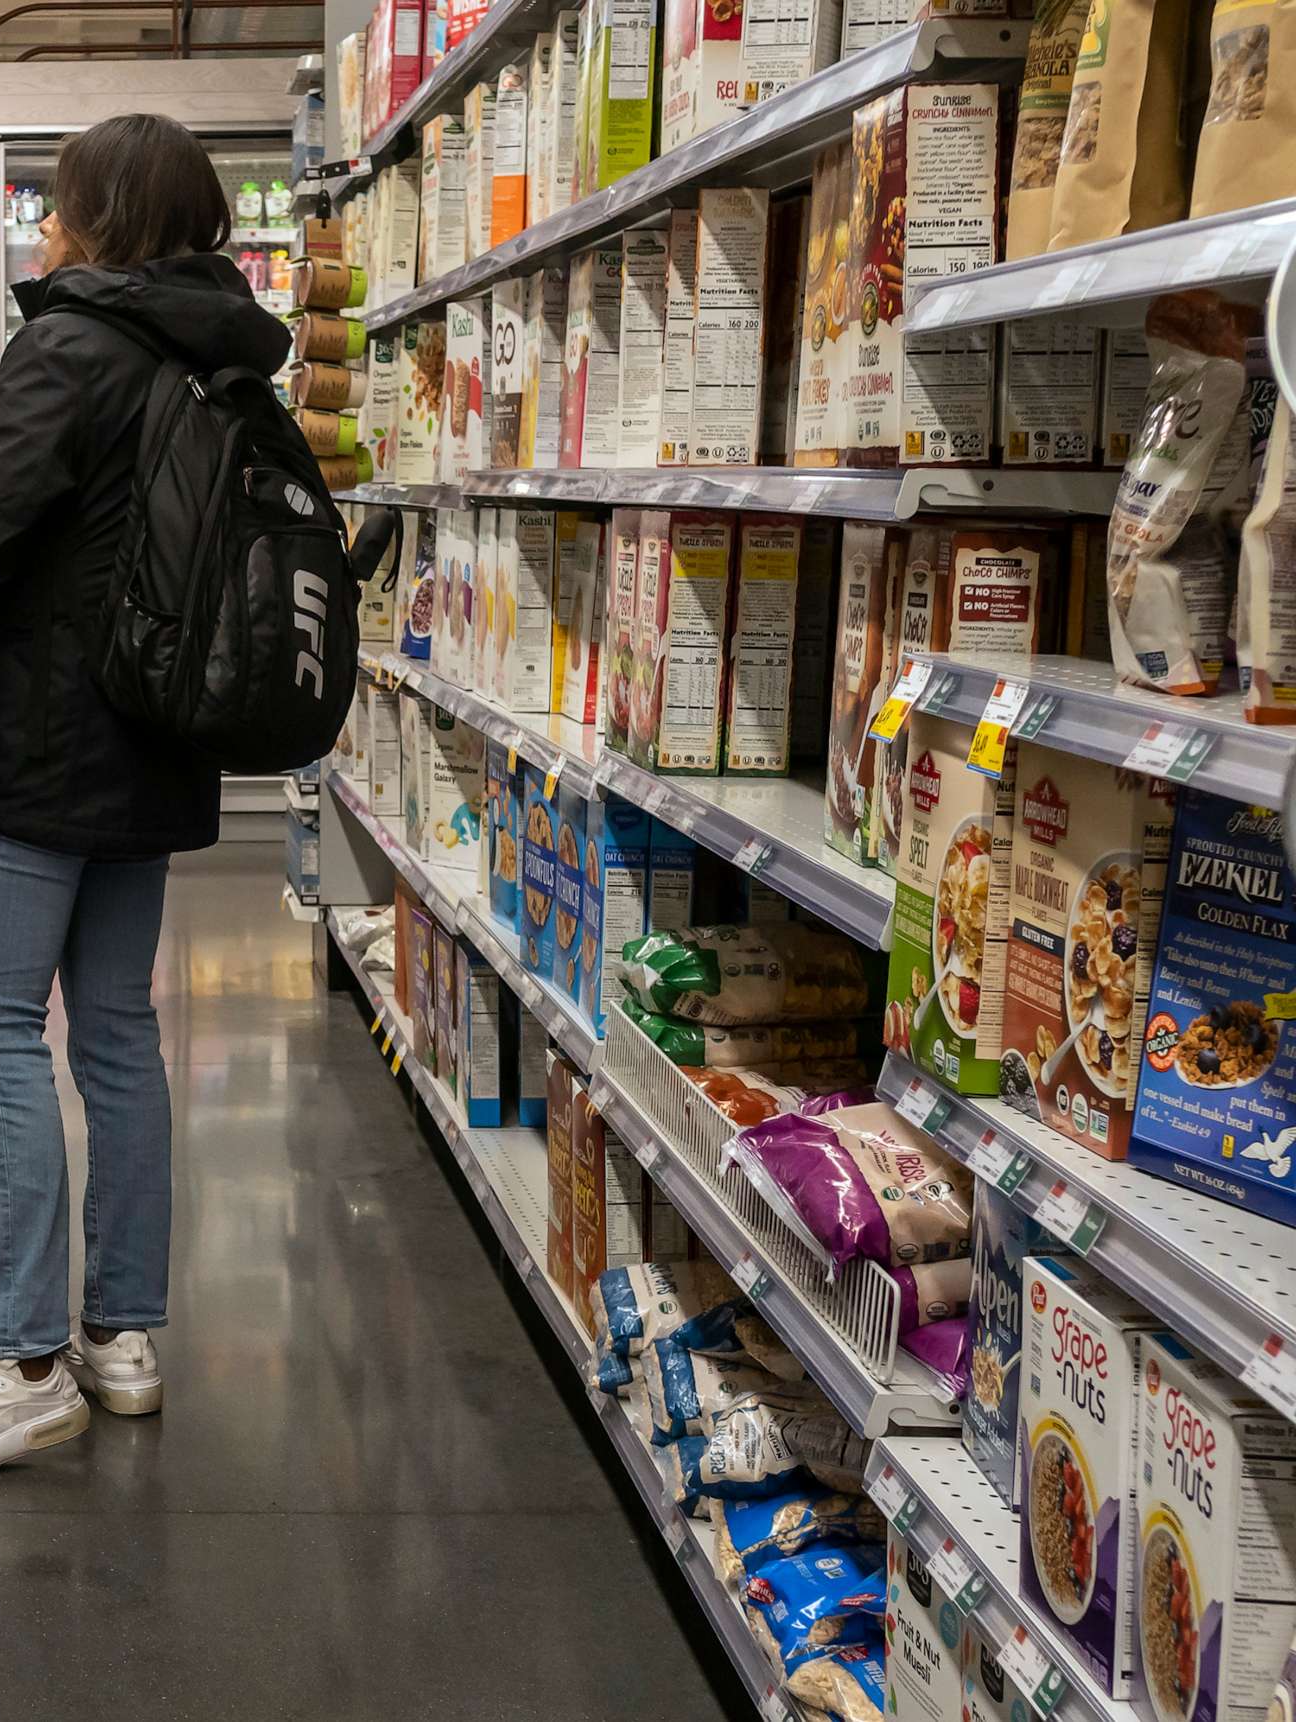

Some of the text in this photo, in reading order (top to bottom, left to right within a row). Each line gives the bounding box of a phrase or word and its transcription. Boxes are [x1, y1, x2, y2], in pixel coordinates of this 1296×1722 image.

[909, 219, 983, 228] Nutrition Facts
[907, 265, 938, 273] Calories
[950, 262, 966, 273] 150
[451, 307, 474, 338] Kashi
[698, 320, 759, 328] Calories 160 200
[518, 514, 552, 527] Kashi
[975, 588, 990, 597] NO
[974, 602, 989, 611] NO
[293, 569, 329, 700] UFC
[434, 762, 478, 776] Marshmallow
[434, 772, 457, 786] Galaxy
[1024, 799, 1066, 829] ARROWHEAD
[993, 838, 1013, 847] Calor
[1033, 825, 1054, 841] MILLS
[605, 852, 617, 862] OAT
[909, 834, 930, 870] SPELT
[1186, 836, 1235, 857] SPROUTED
[524, 849, 555, 889] SPOONFULS
[1030, 850, 1054, 873] ORGANIC
[1176, 850, 1284, 903] EZEKIEL
[1015, 864, 1069, 914] MAPLE BUCKWHEAT
[1198, 902, 1290, 941] GOLDEN FLAX
[1021, 926, 1055, 950] GLUTEN FREE
[1160, 966, 1185, 989] Barley
[1186, 976, 1204, 990] and
[1239, 967, 1265, 985] Wheat
[1267, 977, 1286, 990] and
[1157, 988, 1173, 1001] and
[1146, 1032, 1179, 1053] ORGANIC
[1140, 1105, 1151, 1117] of
[1143, 1087, 1254, 1133] one vessel and make bread
[1230, 1096, 1287, 1121] put them in
[1174, 1163, 1190, 1176] NET
[969, 1223, 1020, 1334] Alpen
[1051, 1305, 1108, 1380] grape
[1056, 1360, 1107, 1425] -nuts
[1163, 1387, 1217, 1470] grape
[710, 1449, 727, 1475] RICE
[1167, 1448, 1214, 1519] -nuts
[897, 1607, 942, 1672] Fruit & Nut
[904, 1643, 932, 1687] Muesli
